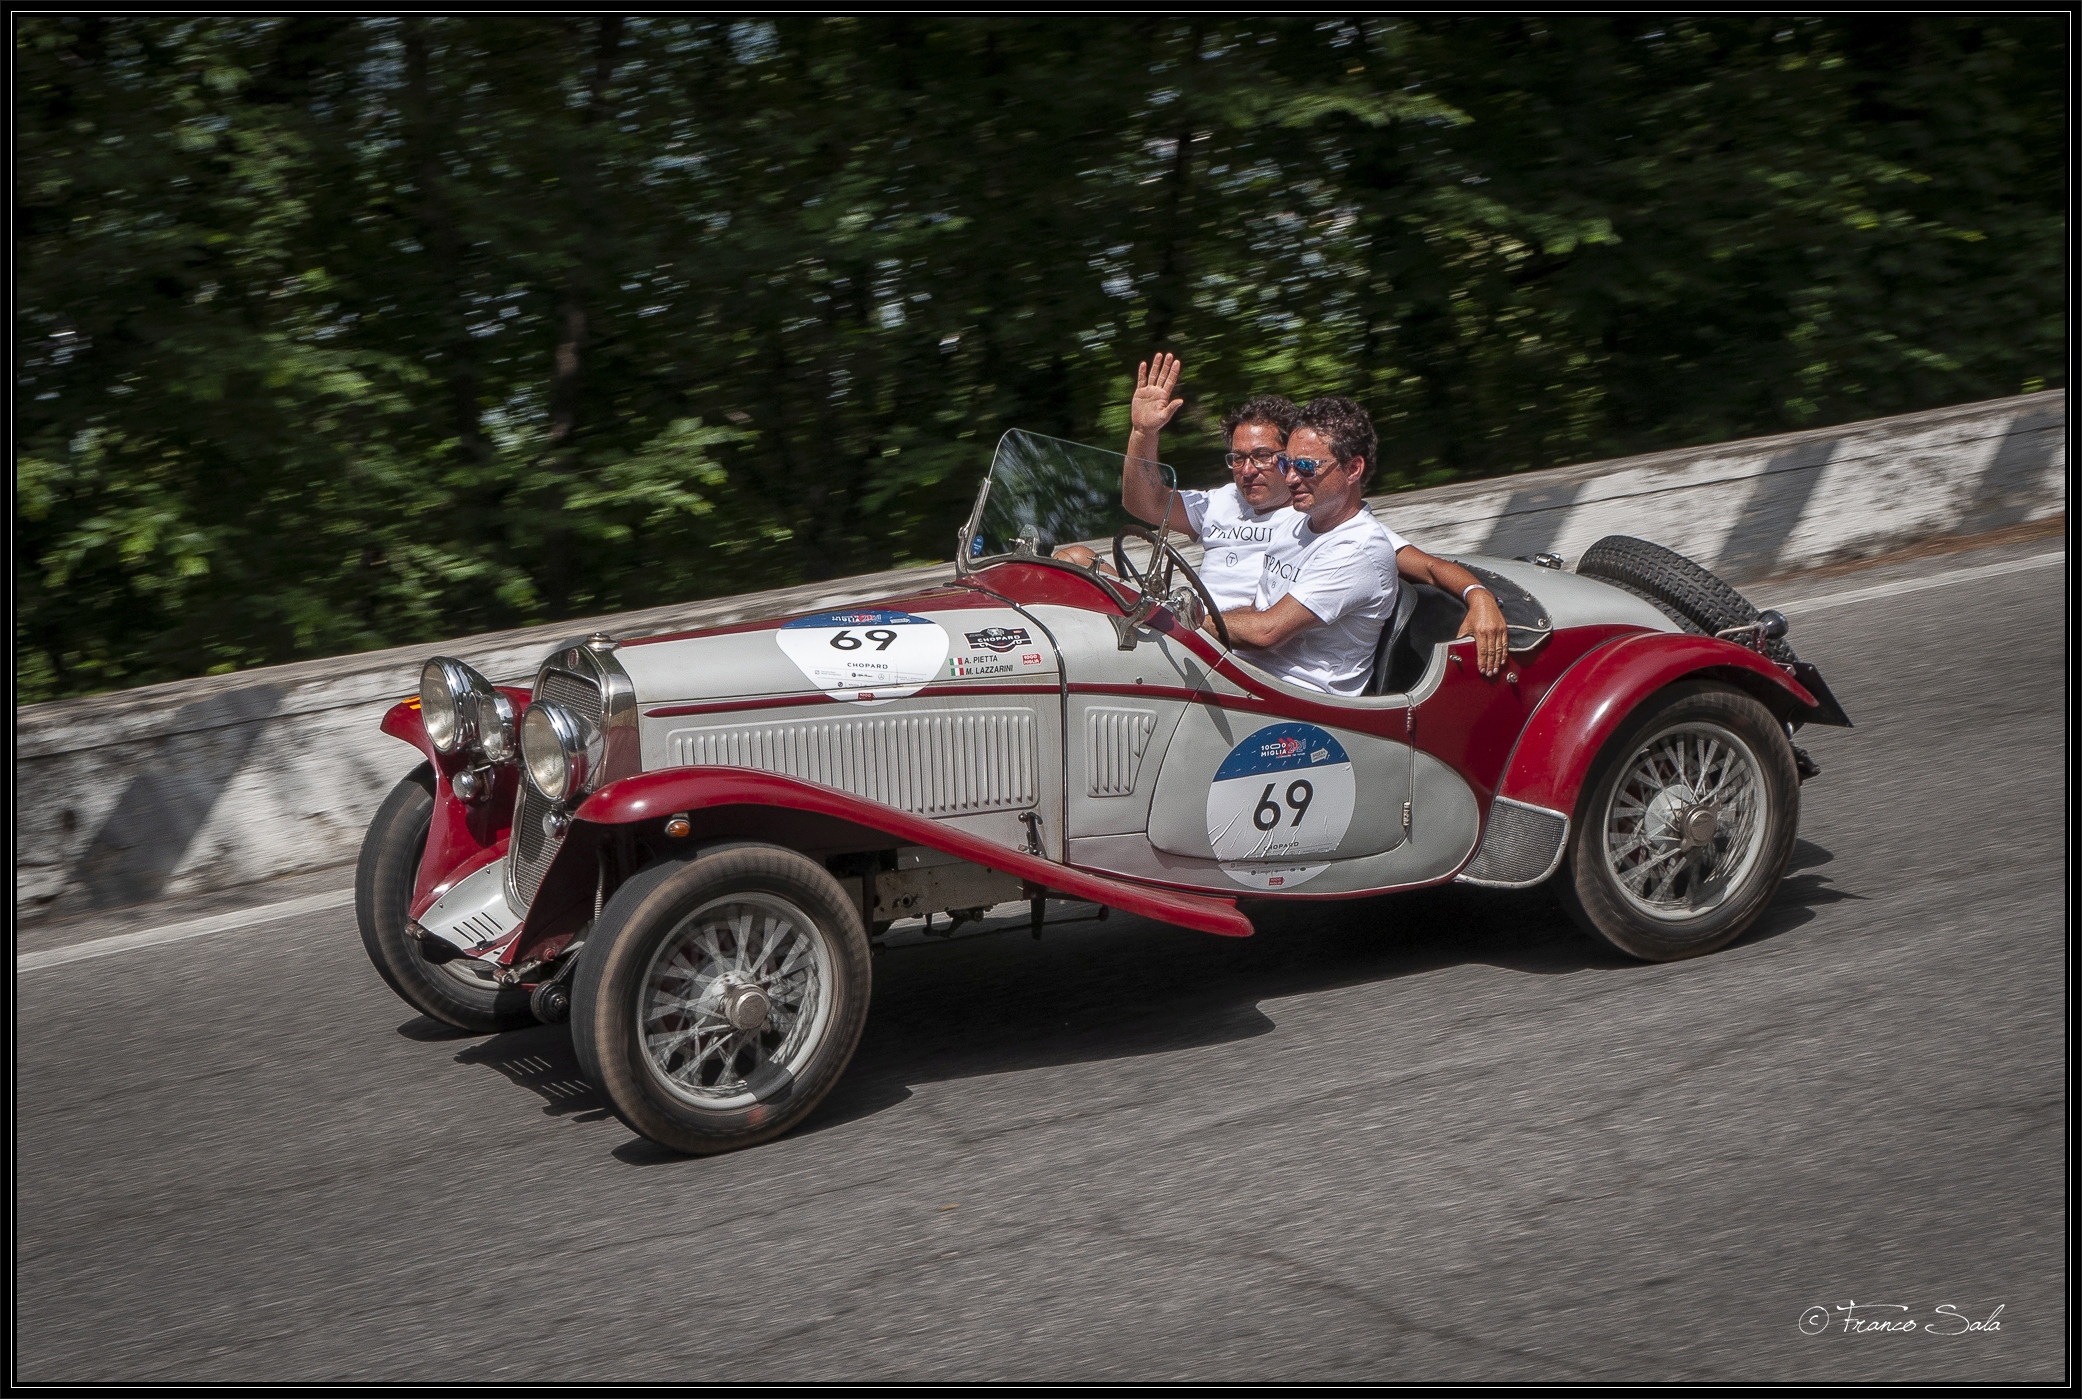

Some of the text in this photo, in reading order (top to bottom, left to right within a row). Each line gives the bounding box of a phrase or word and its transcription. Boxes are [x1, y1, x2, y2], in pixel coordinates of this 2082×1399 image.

[829, 629, 898, 651] 69
[977, 634, 1021, 643] CHOPARD
[973, 655, 998, 663] PIETTA
[847, 662, 888, 670] CHOPARD
[966, 665, 1014, 676] M. LAZZARINI
[1260, 749, 1287, 757] MIGLIA
[1253, 779, 1314, 832] 69
